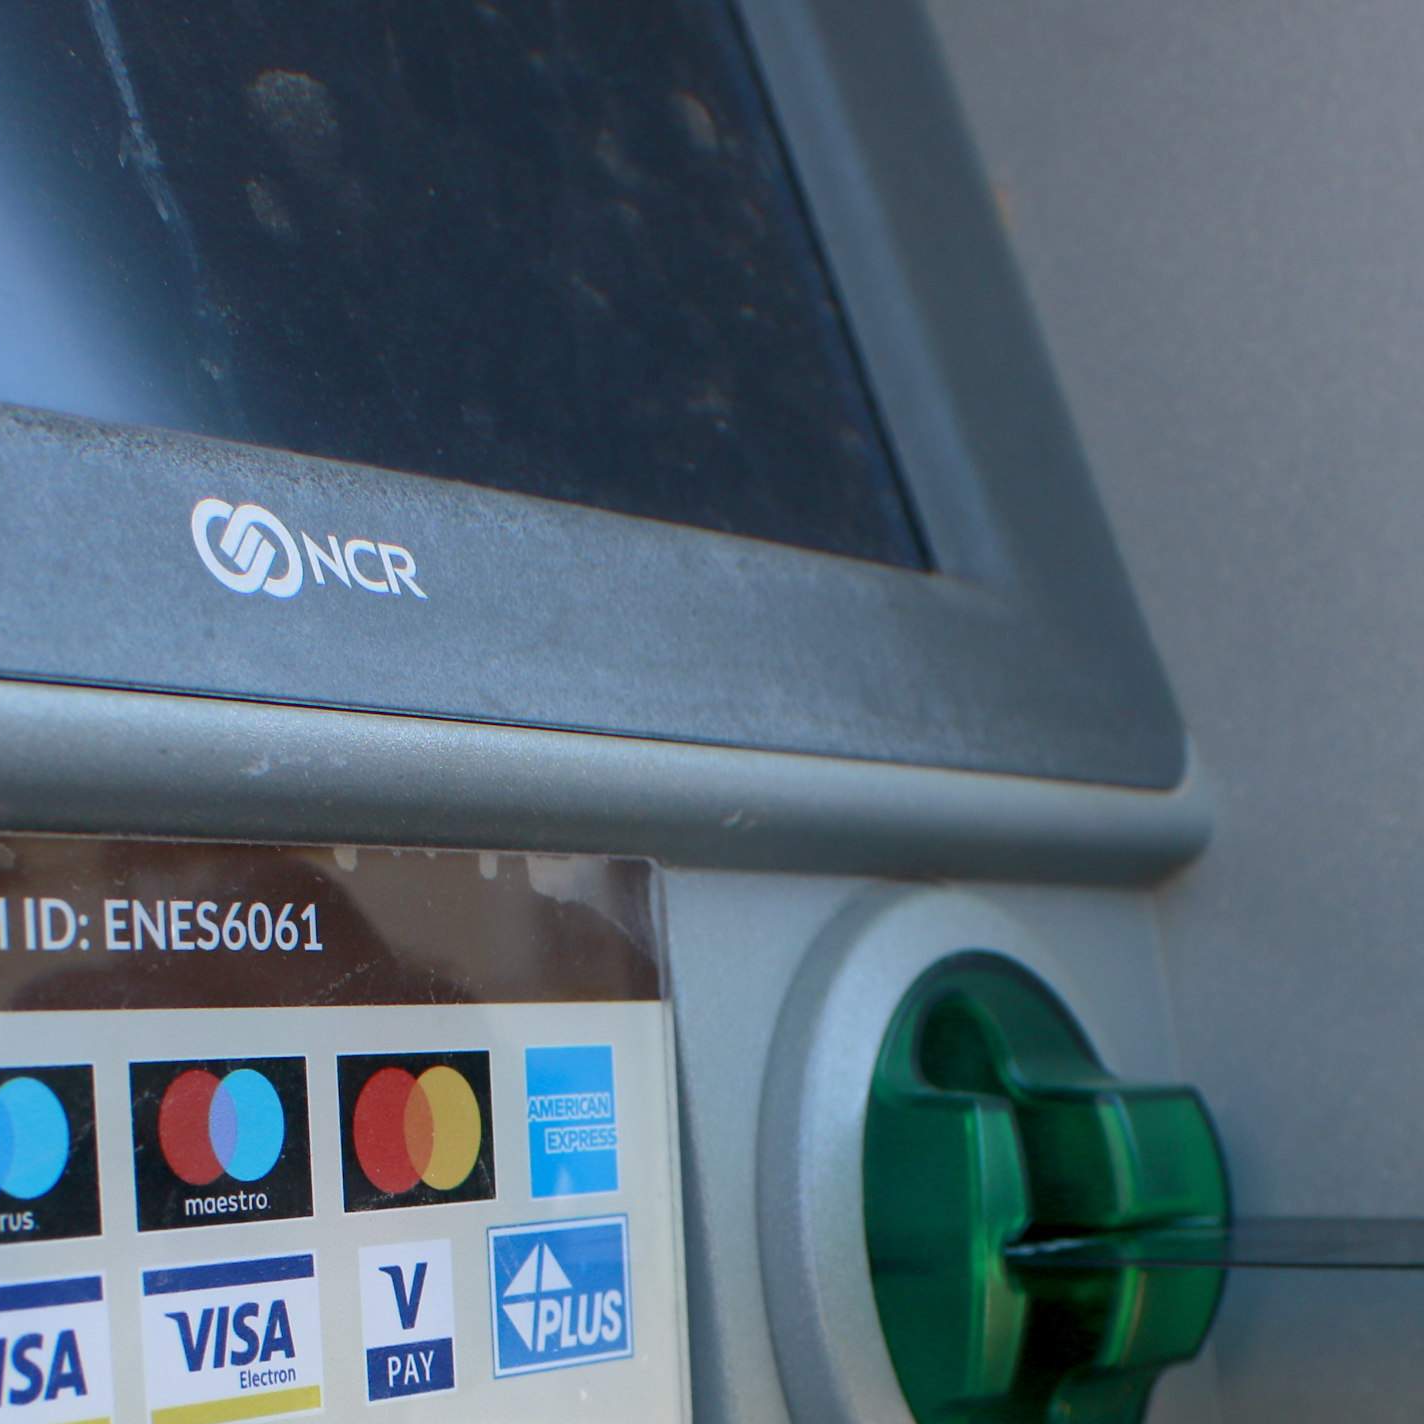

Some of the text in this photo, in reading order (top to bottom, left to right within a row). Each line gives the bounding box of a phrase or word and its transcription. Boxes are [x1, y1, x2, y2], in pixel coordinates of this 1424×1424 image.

[301, 530, 429, 600] NCR
[23, 897, 91, 951] ID:
[103, 899, 324, 952] ENES6061
[528, 1093, 611, 1121] AMERICAN
[546, 1125, 617, 1152] EXPRESS
[185, 1191, 269, 1216] maestro
[378, 1261, 428, 1330] V
[164, 1299, 296, 1373] VISA
[537, 1289, 623, 1353] PLUS
[239, 1366, 296, 1390] Electron
[387, 1350, 435, 1388] PAY
